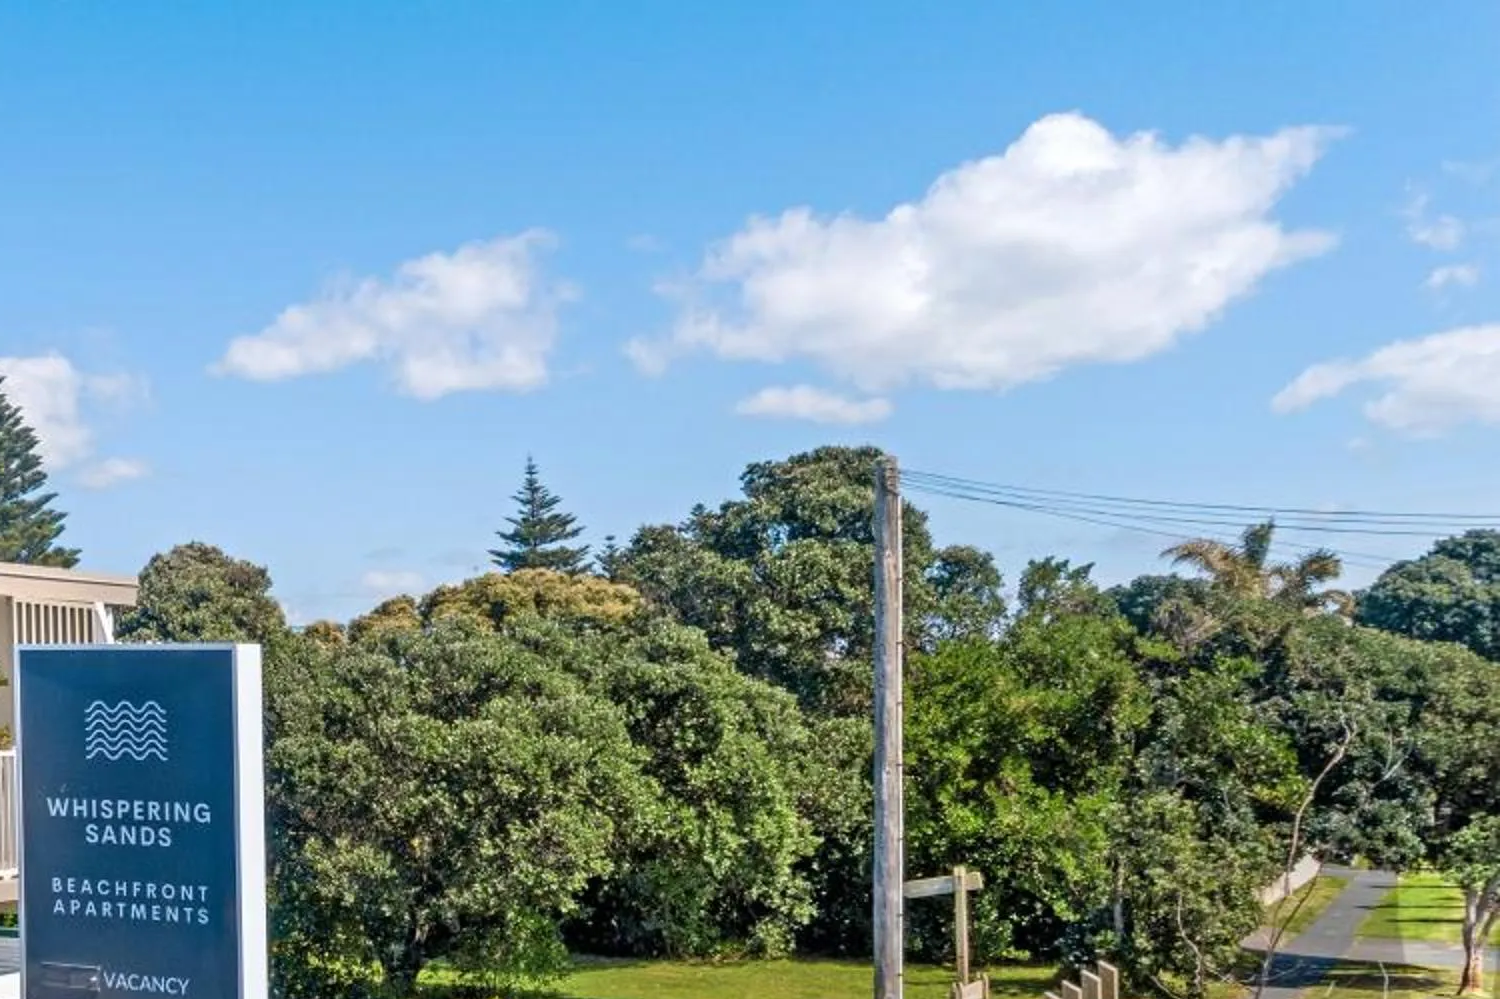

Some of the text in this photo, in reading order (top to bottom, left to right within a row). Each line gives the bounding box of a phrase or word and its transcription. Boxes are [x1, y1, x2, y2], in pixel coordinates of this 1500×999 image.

[46, 797, 211, 823] WHISPERING
[85, 824, 172, 847] SANDS
[52, 877, 209, 902] BEACHFRONT
[53, 899, 209, 925] APARTMENTS
[103, 971, 190, 996] VACANCY
